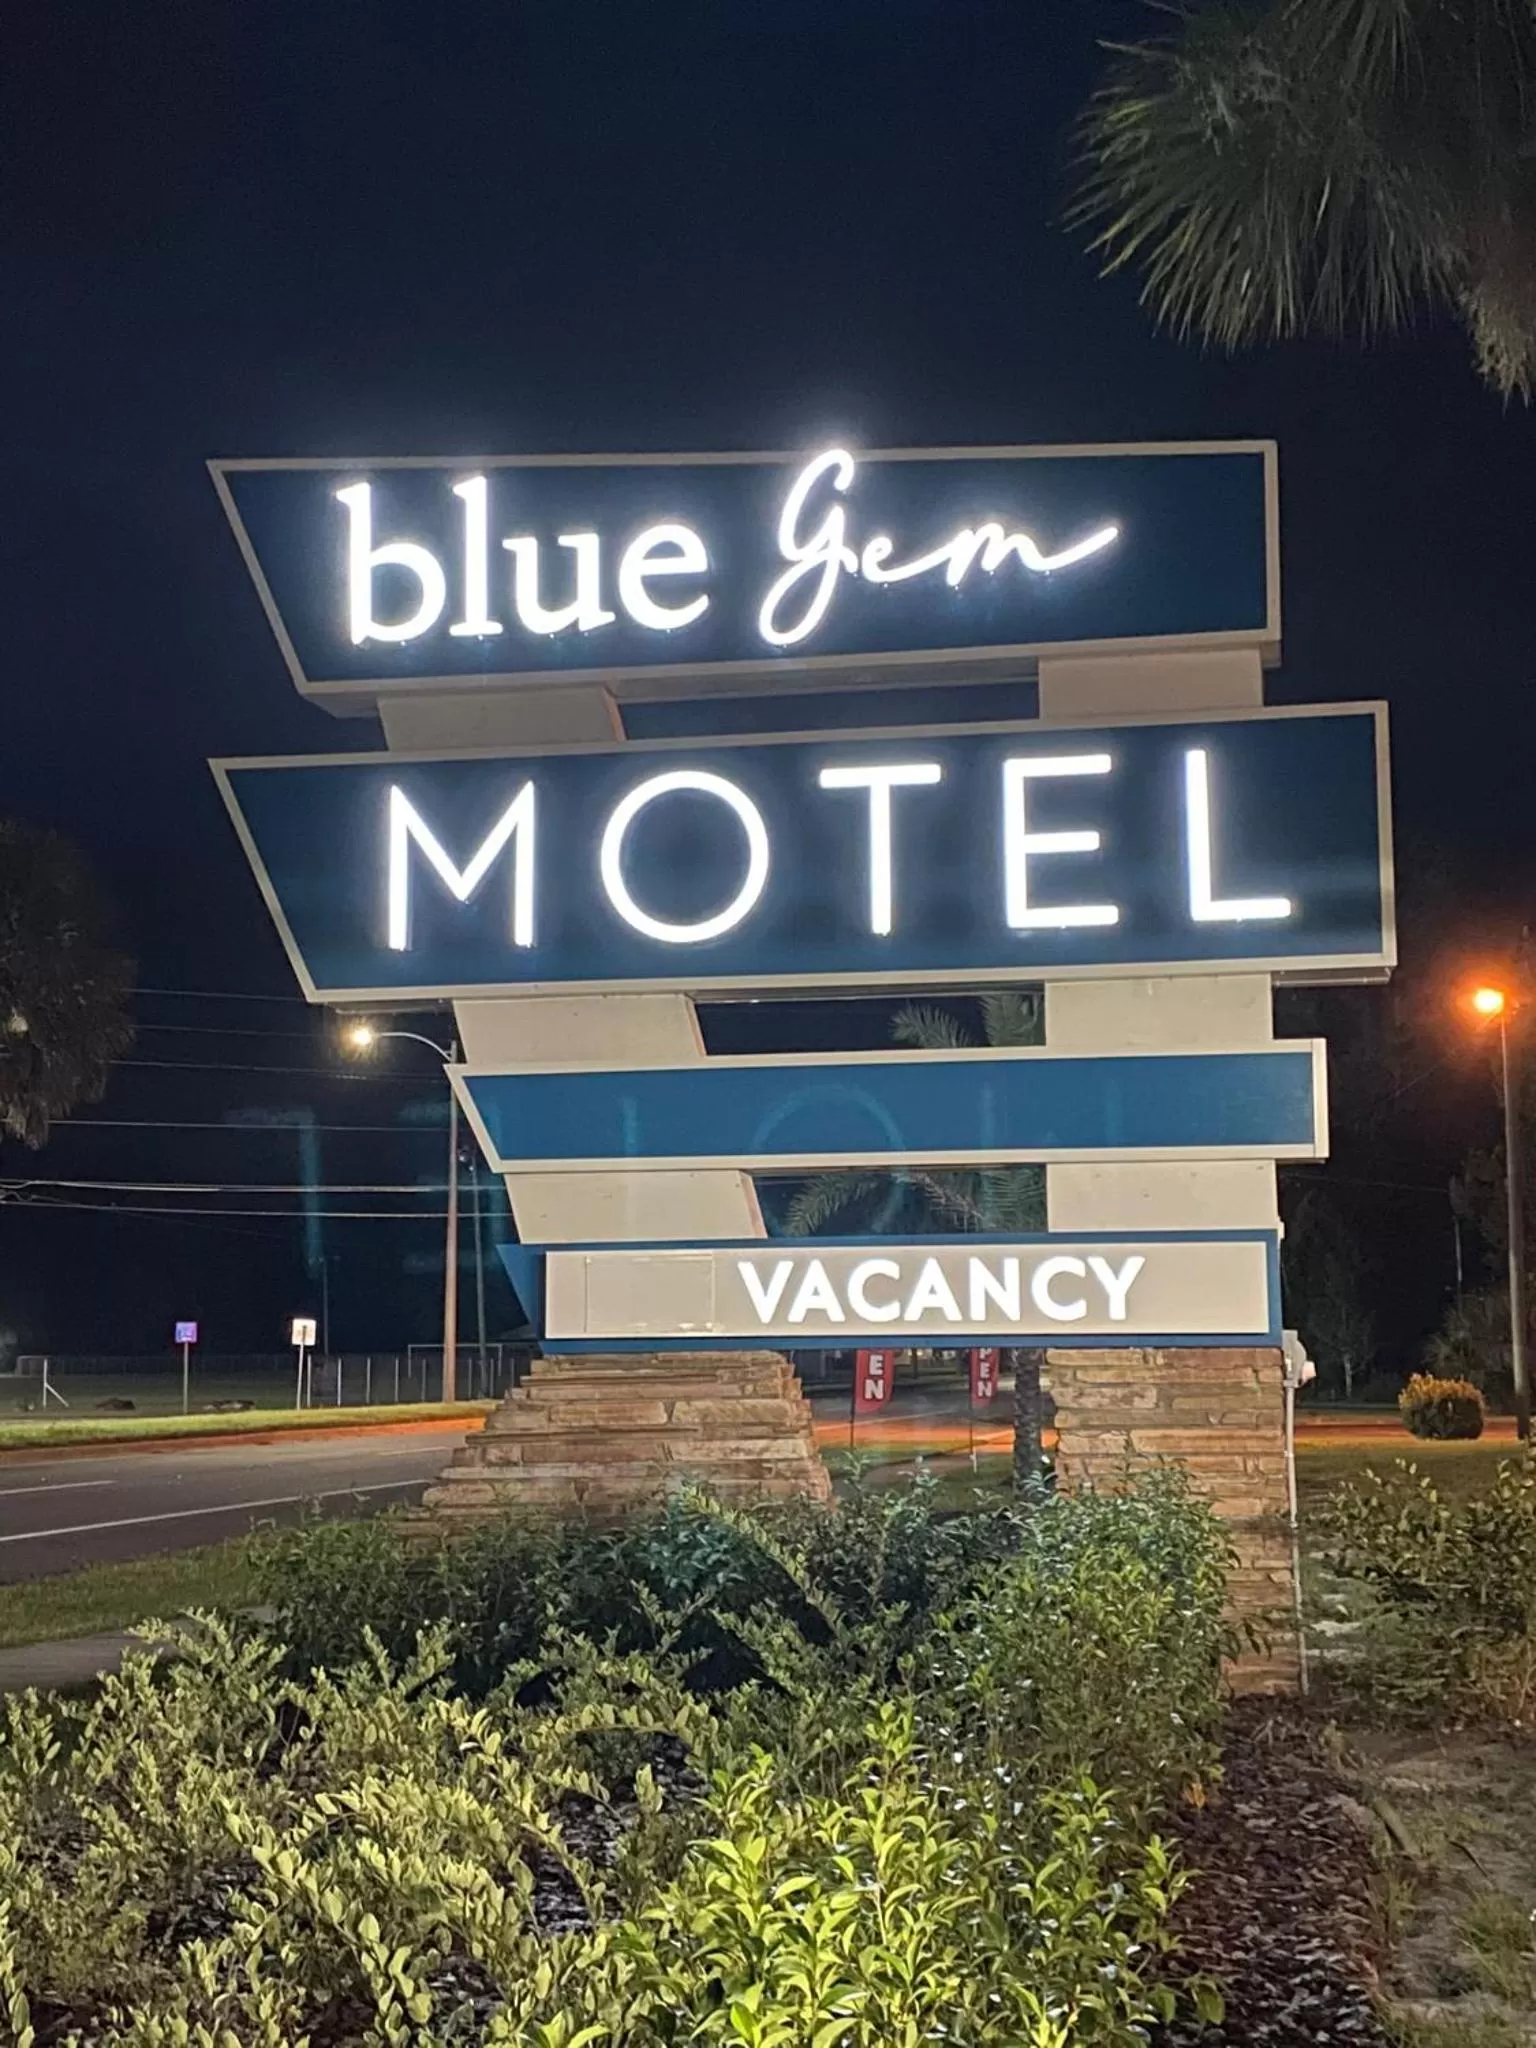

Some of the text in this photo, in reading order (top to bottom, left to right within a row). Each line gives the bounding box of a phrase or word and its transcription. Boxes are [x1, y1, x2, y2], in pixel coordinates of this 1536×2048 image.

[335, 447, 1119, 647] blue Gem
[387, 748, 1292, 951] MOTEL
[737, 1256, 1146, 1323] VACANCY
